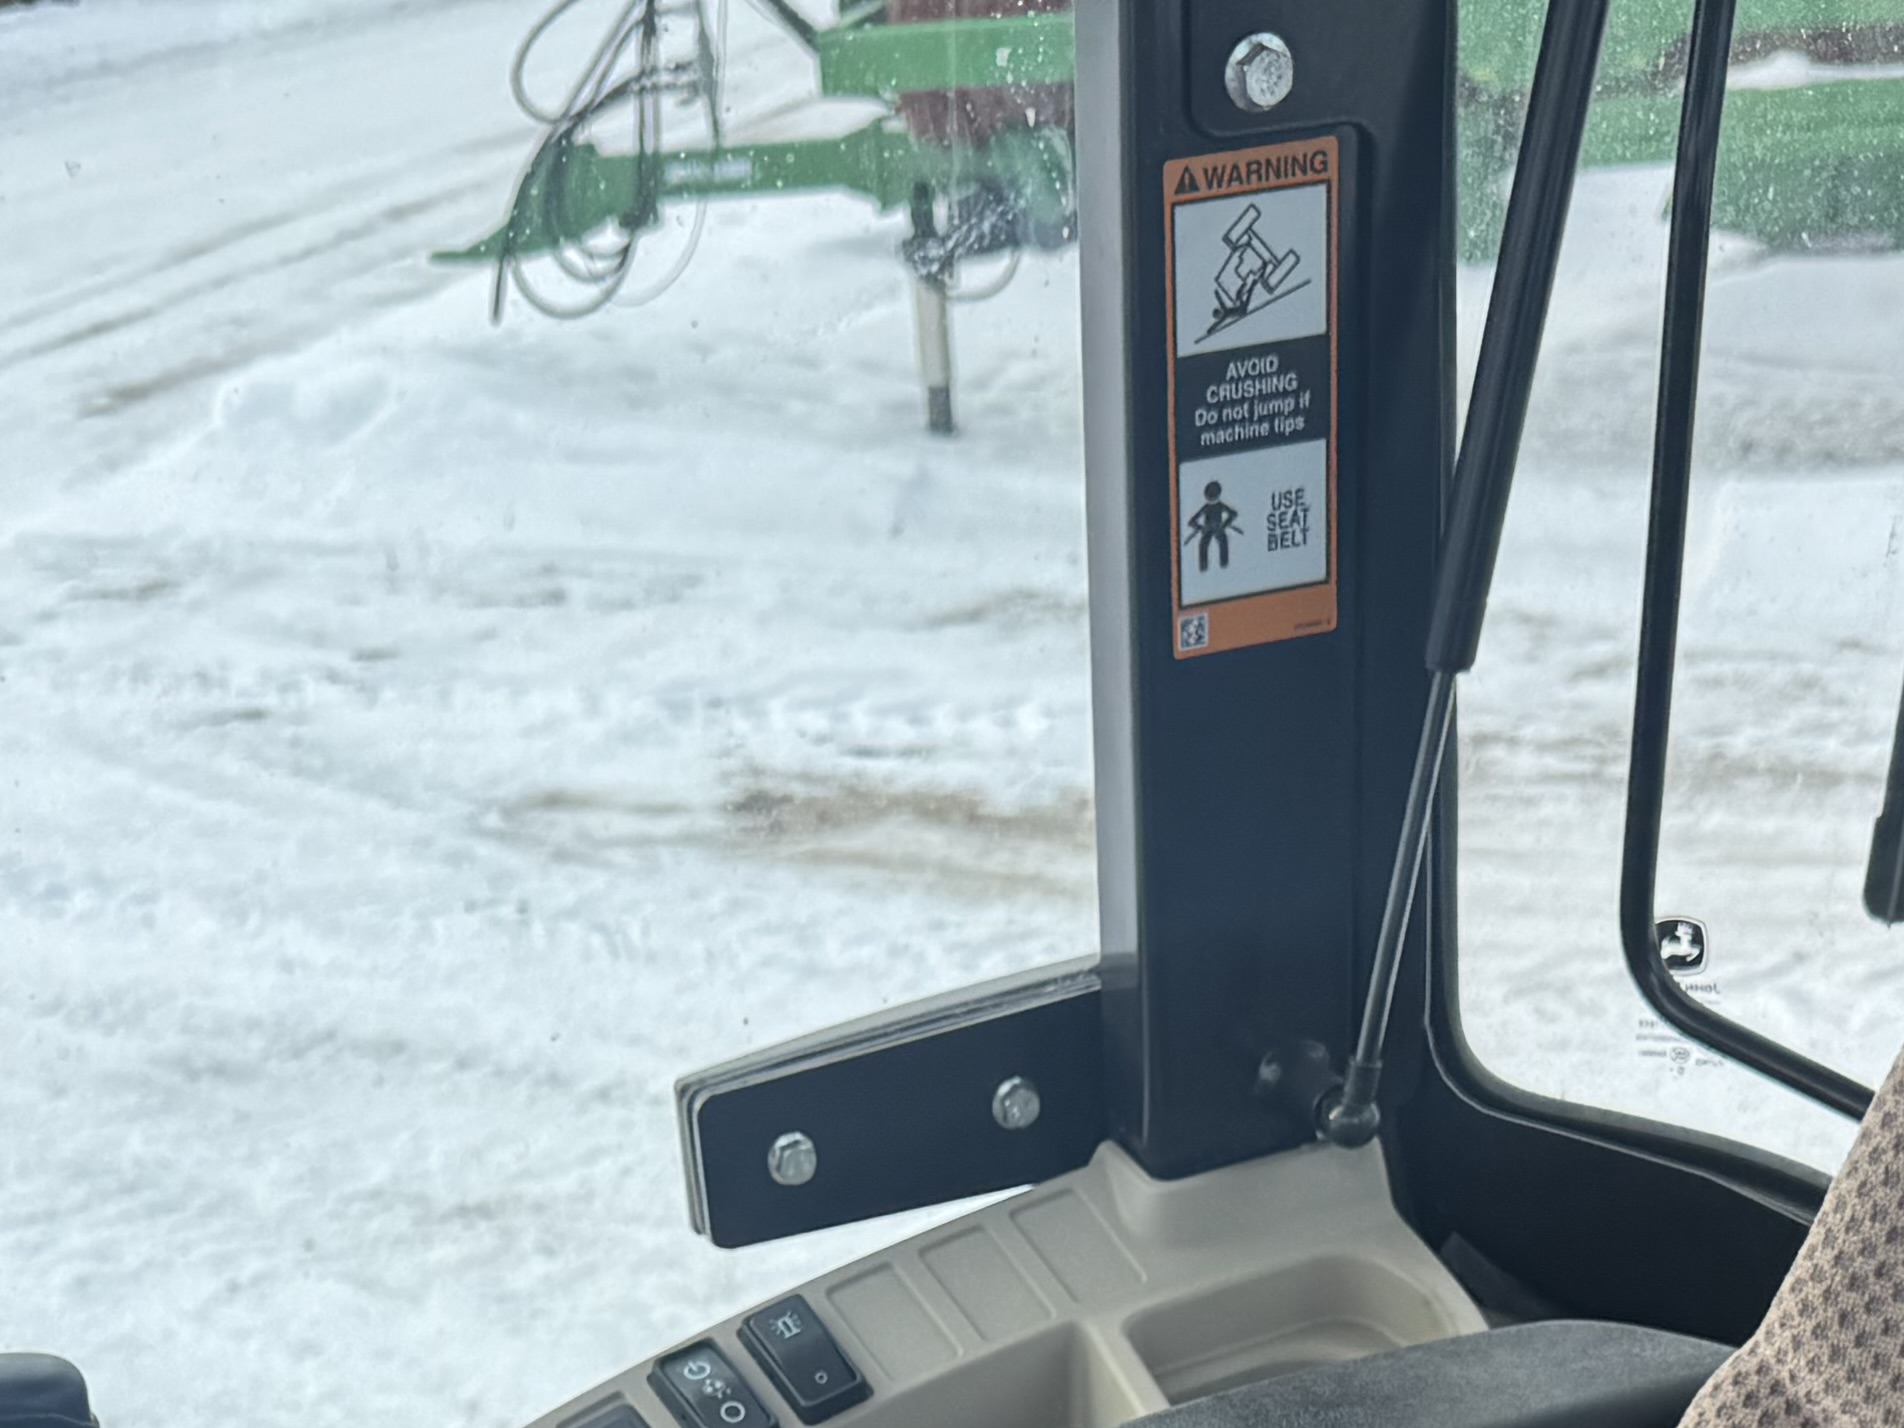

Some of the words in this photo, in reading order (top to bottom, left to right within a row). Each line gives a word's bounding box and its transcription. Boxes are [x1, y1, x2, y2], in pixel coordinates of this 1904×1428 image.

[1203, 150, 1329, 191] WARNING
[1226, 353, 1279, 380] AVOID
[1206, 373, 1298, 403] CRUSHING
[1195, 408, 1218, 427] Do
[1222, 401, 1249, 422] not
[1254, 394, 1295, 421] jump
[1299, 389, 1311, 409] if
[1200, 422, 1270, 446] machine
[1274, 416, 1305, 436] tips
[1271, 487, 1306, 512] USE
[1266, 505, 1310, 532] SEAT
[1267, 526, 1310, 551] BELT
